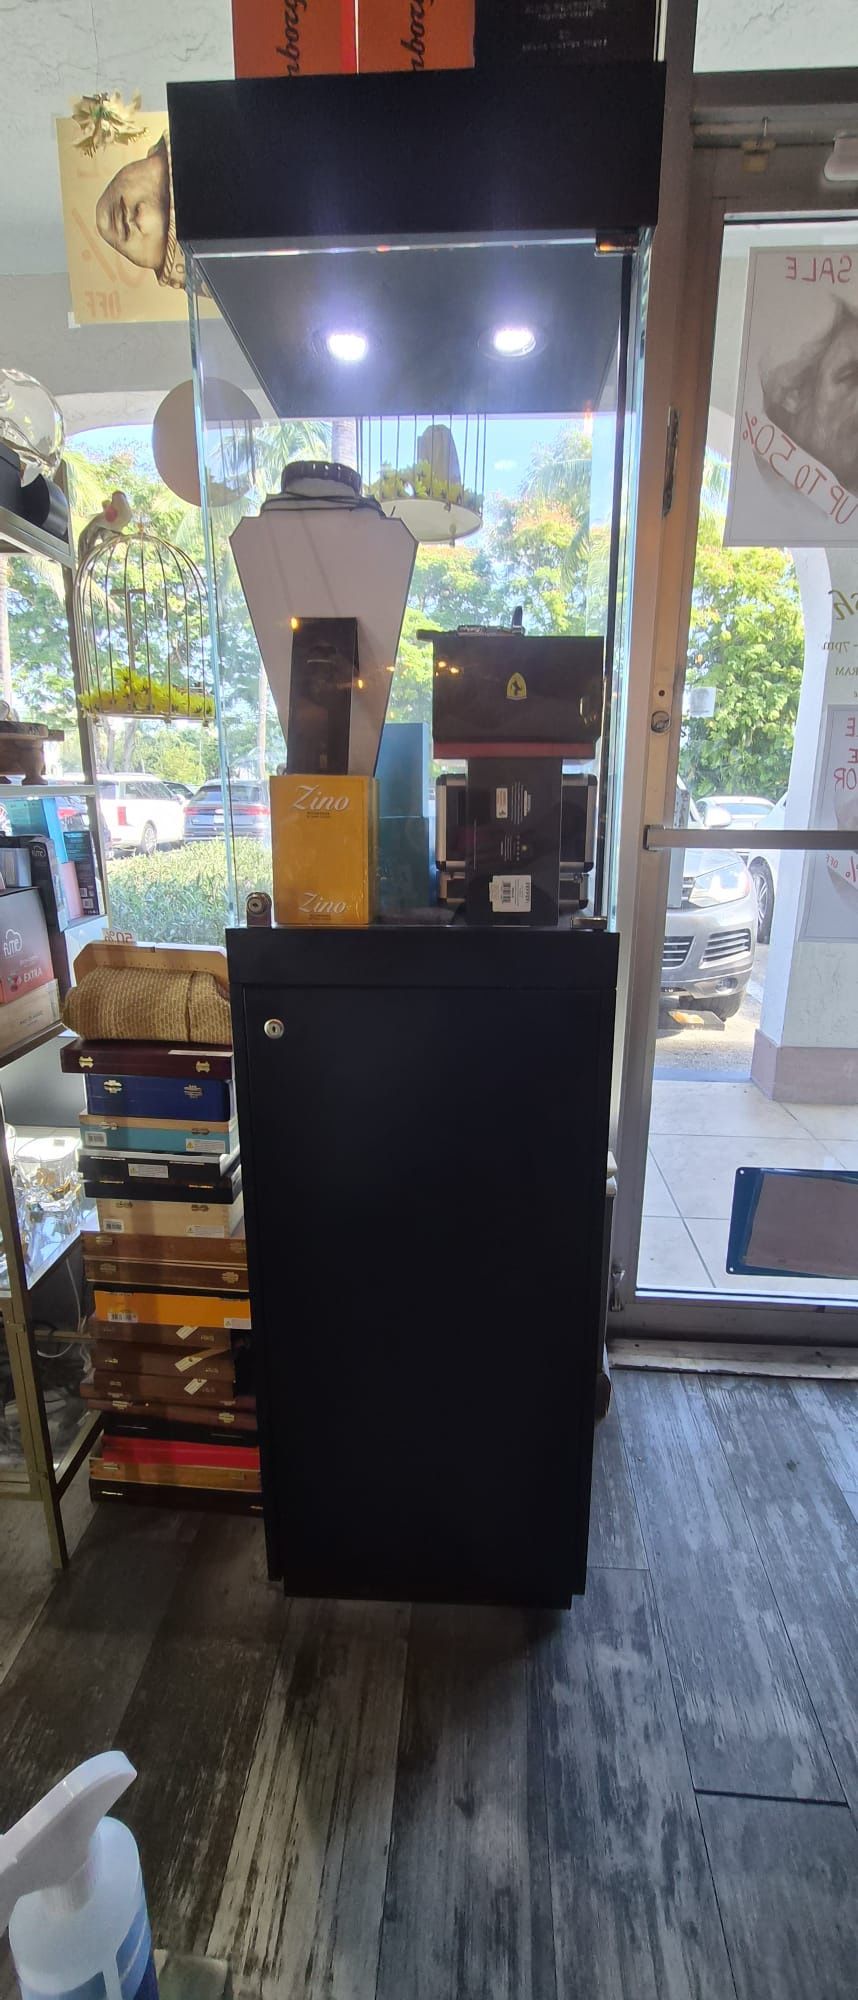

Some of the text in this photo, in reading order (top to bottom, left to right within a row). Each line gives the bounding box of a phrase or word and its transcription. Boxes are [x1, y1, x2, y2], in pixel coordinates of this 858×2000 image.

[292, 785, 350, 811] Zino
[297, 891, 347, 913] Zino
[23, 967, 43, 984] EXTRA
